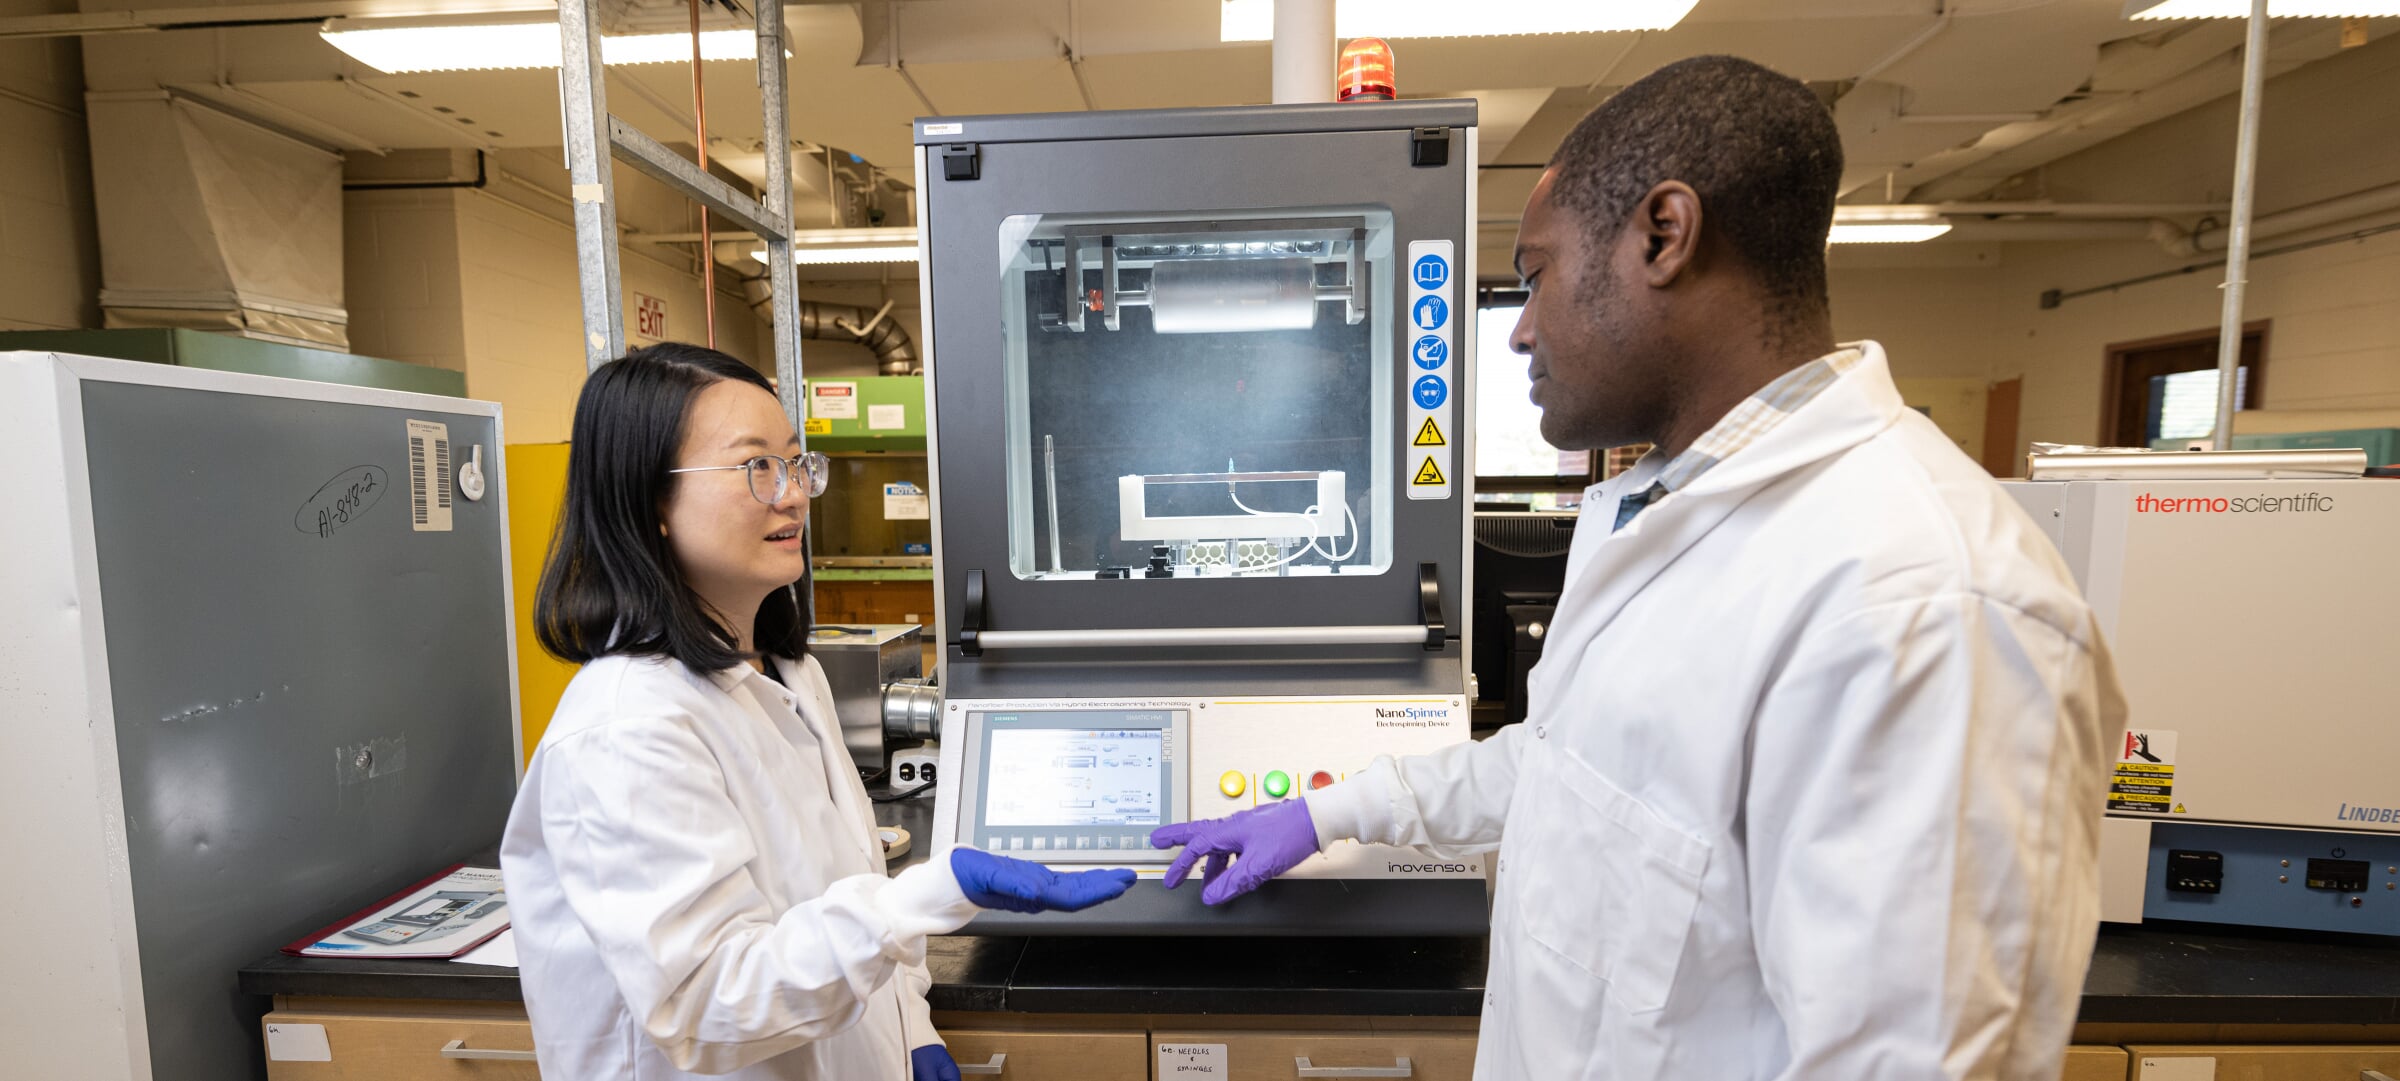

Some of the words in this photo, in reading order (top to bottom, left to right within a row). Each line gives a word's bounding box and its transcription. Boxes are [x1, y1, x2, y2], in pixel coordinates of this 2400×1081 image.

[639, 306, 664, 338] EXIT
[891, 487, 917, 495] NOTIC
[1375, 707, 1448, 720] NanoSpinner
[1376, 720, 1426, 728] Electrospinning
[1162, 727, 1172, 761] TOUCH
[2337, 803, 2400, 823] LINDBE
[1388, 862, 1466, 873] inovenso
